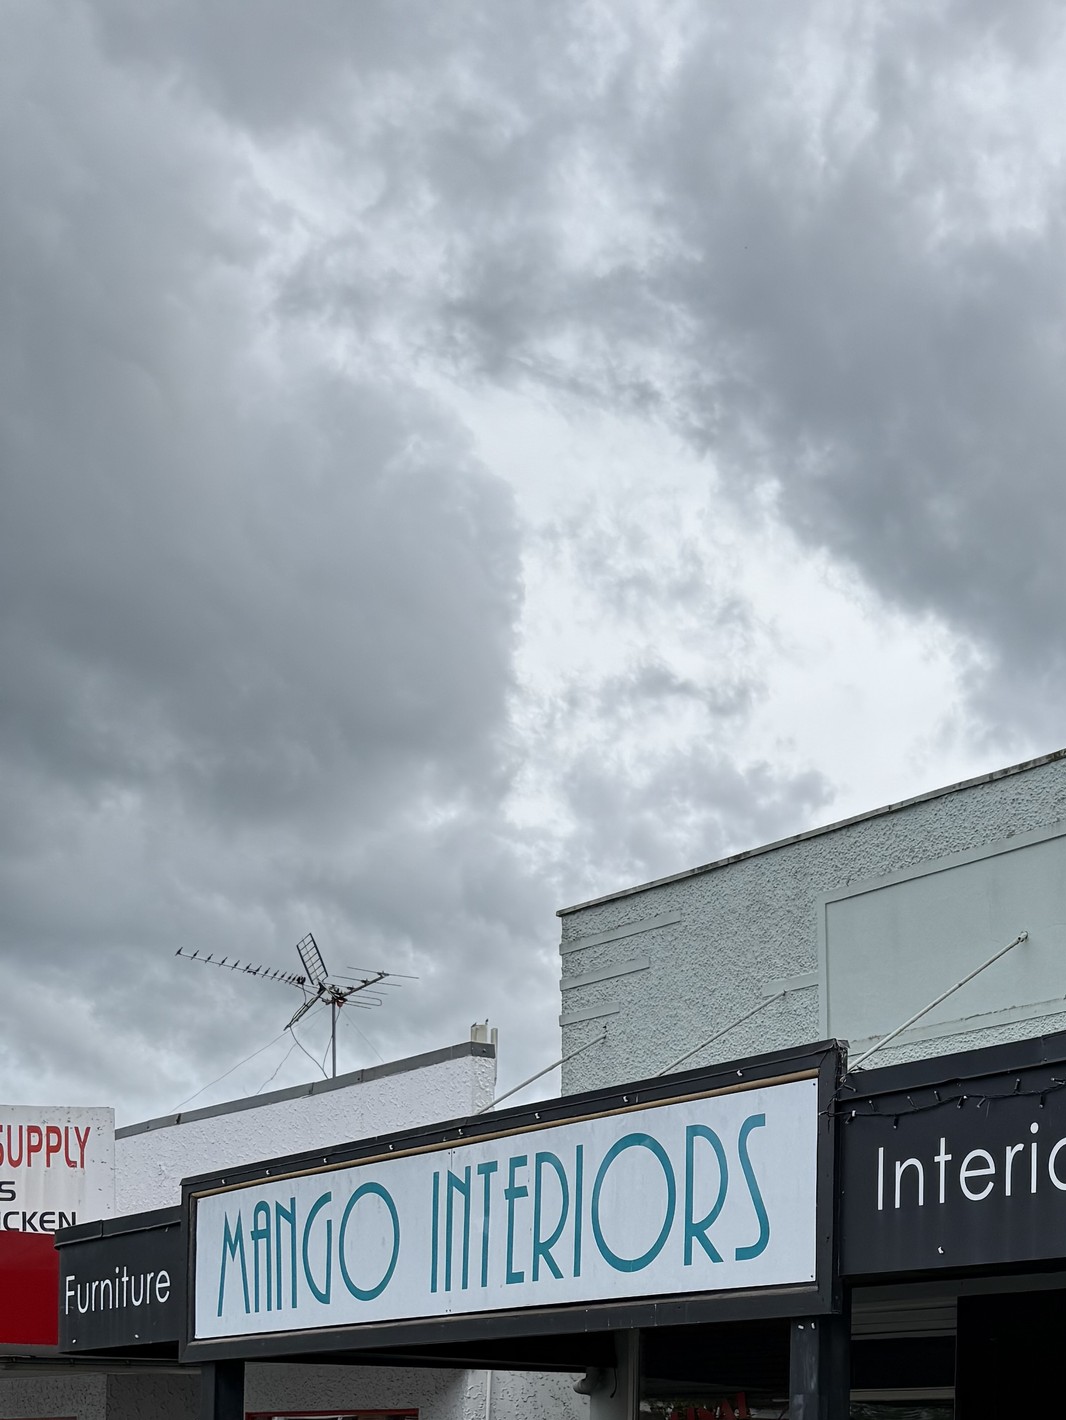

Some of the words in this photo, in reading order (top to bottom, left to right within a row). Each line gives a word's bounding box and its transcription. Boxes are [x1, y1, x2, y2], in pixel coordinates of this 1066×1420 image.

[217, 1181, 400, 1318] MANGO
[431, 1112, 771, 1293] INTERIORS
[64, 1266, 171, 1316] Furniture
